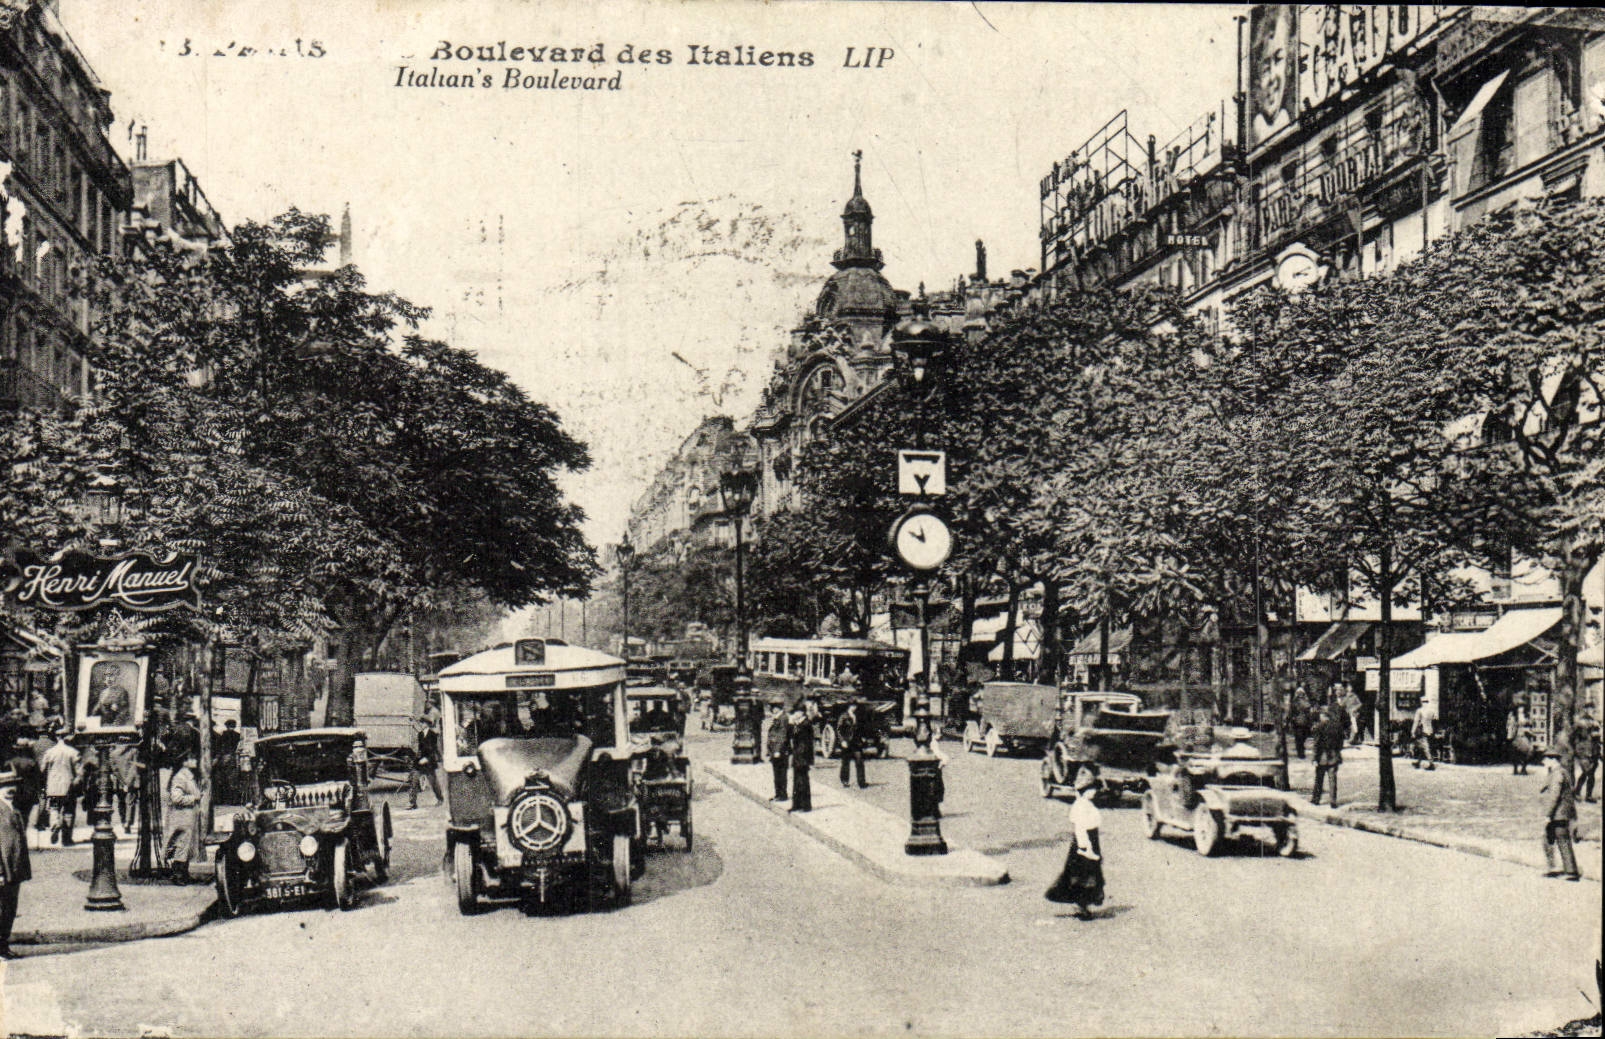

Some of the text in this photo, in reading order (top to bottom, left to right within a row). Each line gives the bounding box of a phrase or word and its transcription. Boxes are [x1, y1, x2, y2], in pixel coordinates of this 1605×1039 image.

[1167, 235, 1208, 247] HOTEL
[18, 559, 192, 605] Henri Manuel
